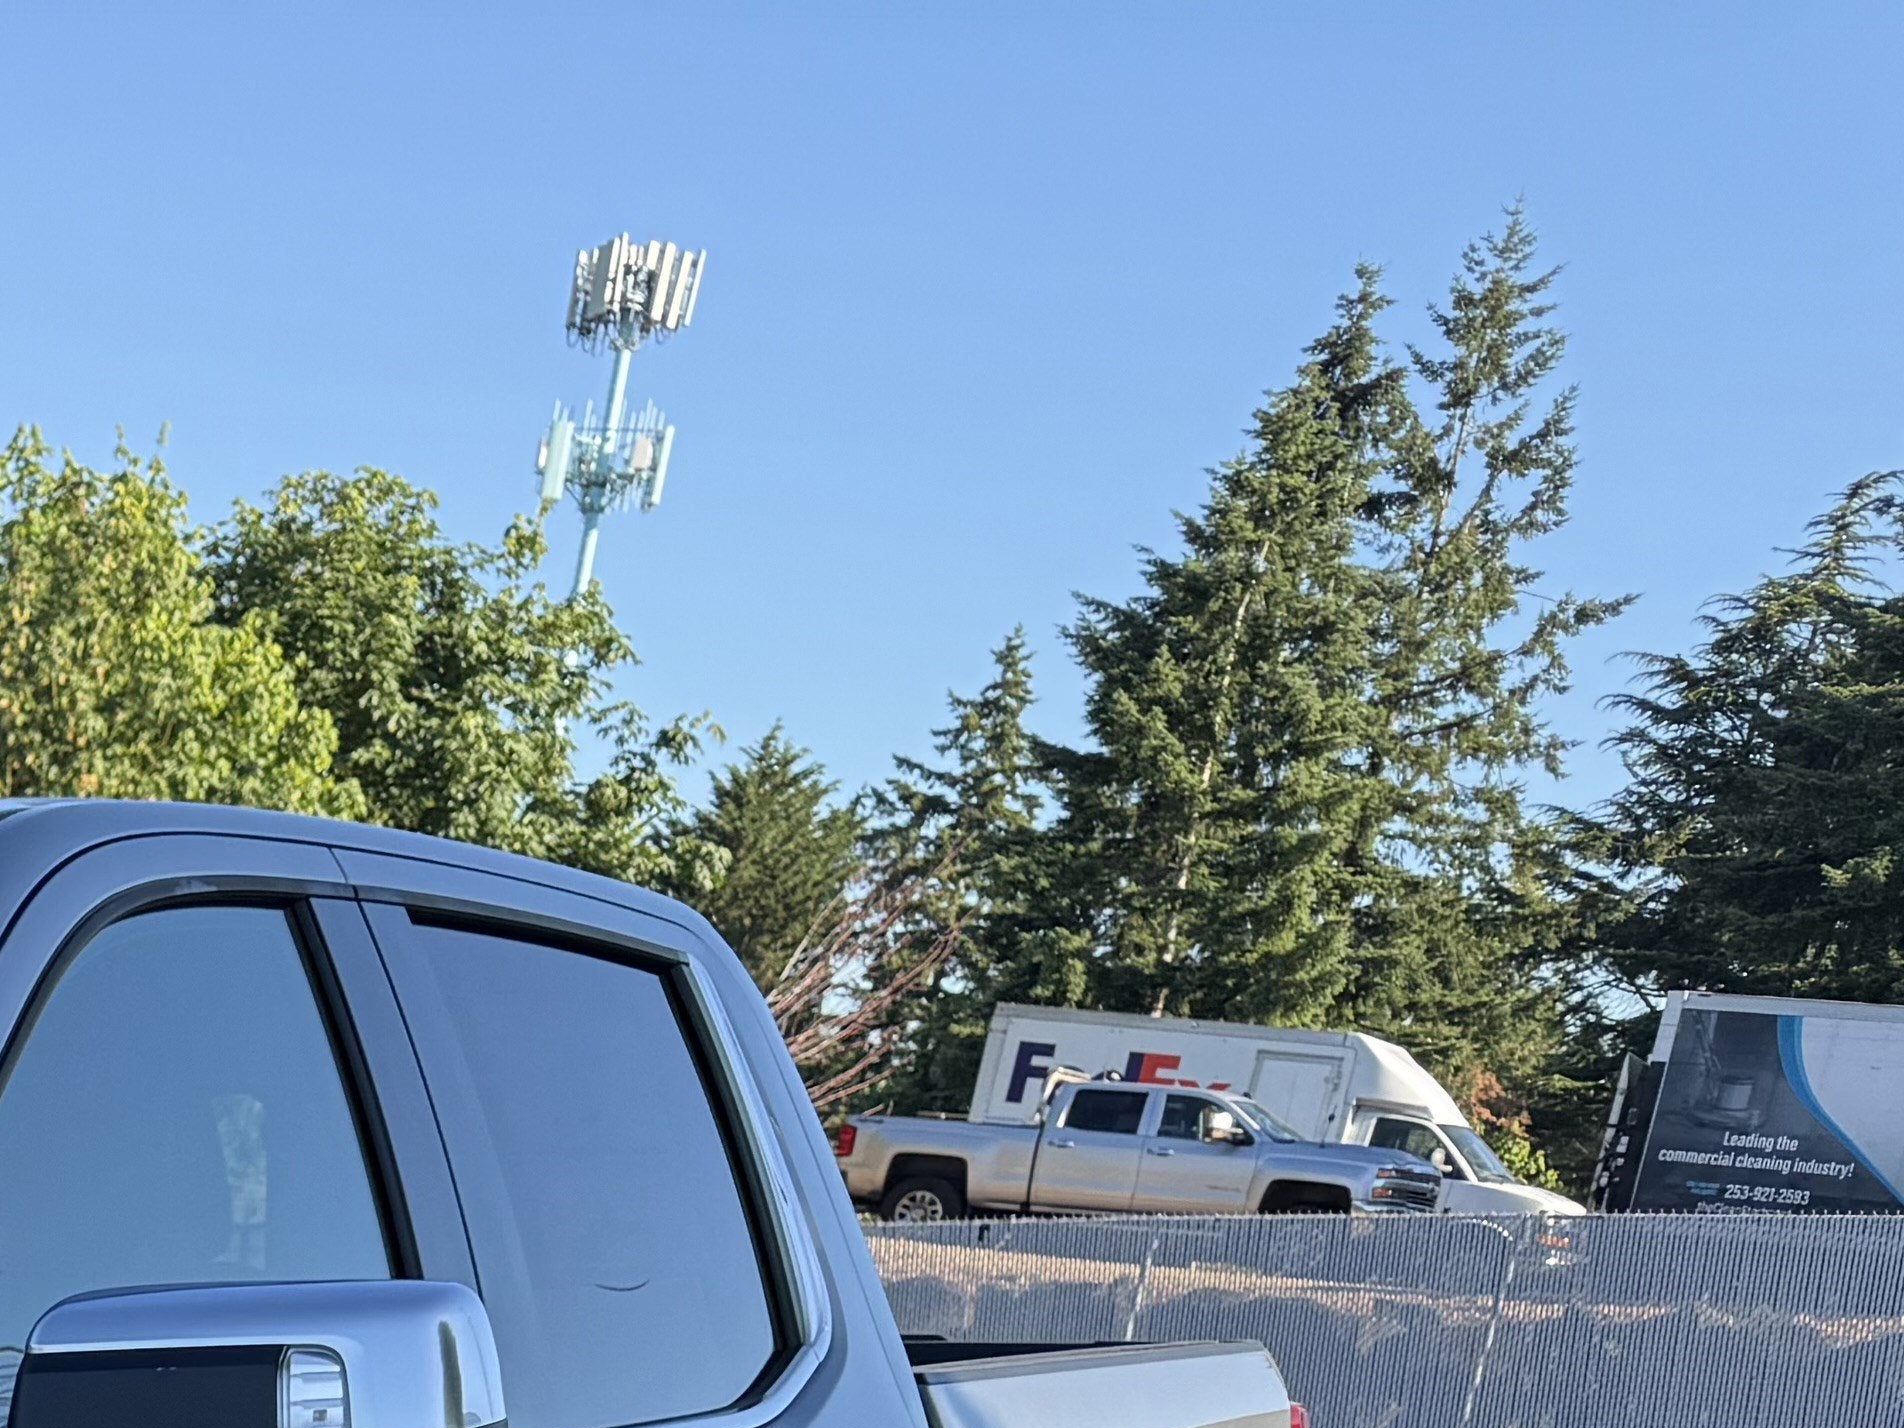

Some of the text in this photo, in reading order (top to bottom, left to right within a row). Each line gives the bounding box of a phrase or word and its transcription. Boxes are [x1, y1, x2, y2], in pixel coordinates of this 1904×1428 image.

[1723, 1131, 1799, 1153] Leading the
[1658, 1149, 1855, 1181] commercial cleaning industry!
[1724, 1183, 1811, 1206] 253-921-2593
